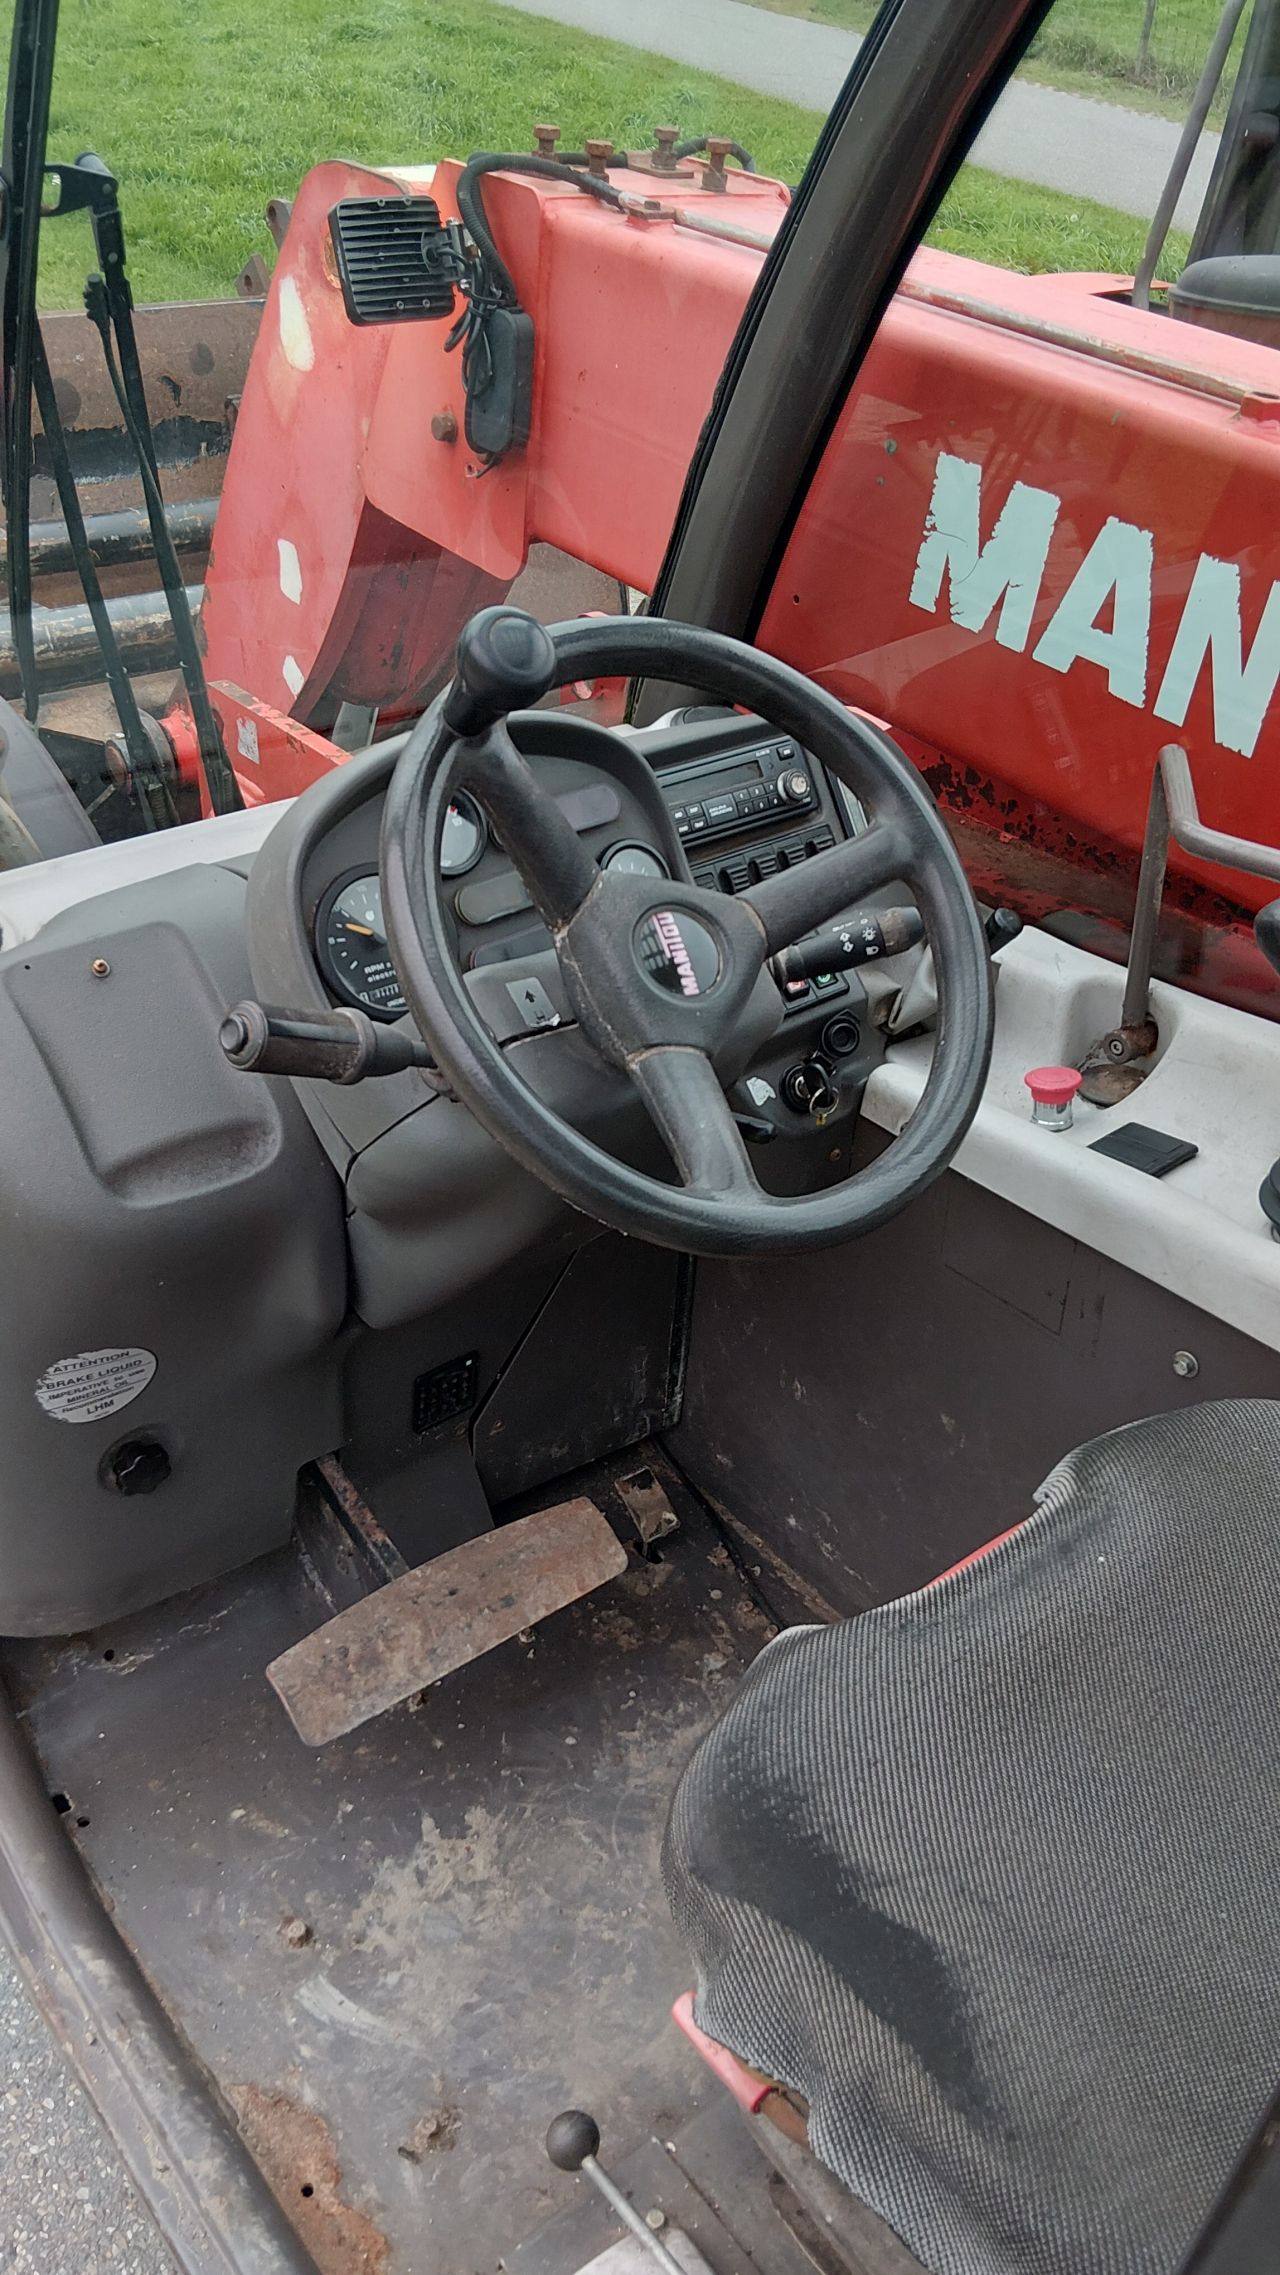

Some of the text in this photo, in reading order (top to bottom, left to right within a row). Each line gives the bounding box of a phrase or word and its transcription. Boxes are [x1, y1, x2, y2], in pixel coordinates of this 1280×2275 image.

[909, 451, 1280, 758] MAN
[652, 911, 700, 996] MANITOU
[53, 1351, 131, 1373] ATTENTION
[46, 1373, 94, 1390] BRAKE
[98, 1359, 142, 1377] LIQUID
[48, 1380, 109, 1400] IMPERATIVE
[67, 1386, 111, 1403] MINERAL
[87, 1399, 115, 1415] LHM
